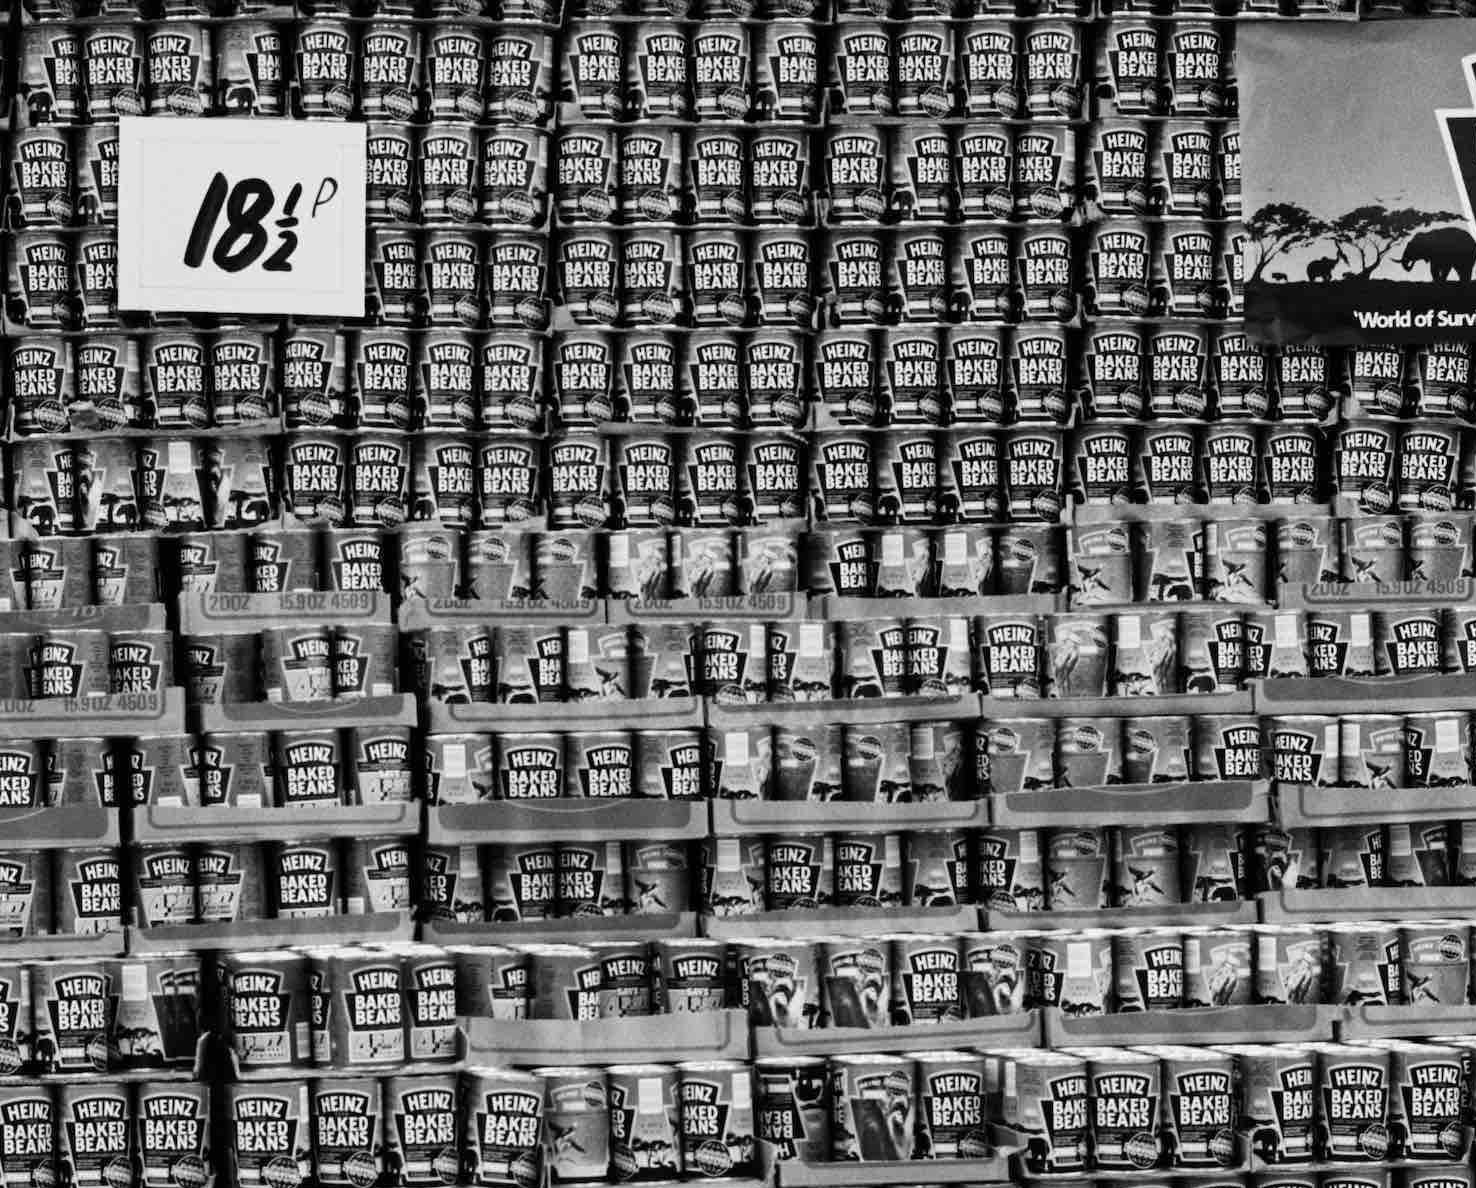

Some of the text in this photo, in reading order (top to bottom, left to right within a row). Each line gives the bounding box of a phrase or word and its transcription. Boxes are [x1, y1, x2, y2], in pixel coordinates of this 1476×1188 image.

[90, 39, 129, 55] HEINZ
[438, 39, 476, 56] HEINZ
[88, 57, 132, 71] BAKED
[435, 57, 479, 73] BAKED
[89, 71, 132, 84] BEANS
[435, 70, 477, 84] BEANS
[965, 138, 1004, 154] HEINZ
[962, 156, 1007, 170] BAKED
[962, 170, 1006, 183] BEANS
[1414, 310, 1434, 327] of
[565, 344, 604, 361] HEINZ
[826, 344, 867, 359] HEINZ
[562, 364, 607, 378] BAKED
[823, 362, 869, 375] BAKED
[562, 377, 606, 390] BEANS
[823, 375, 868, 387] BEANS
[1345, 433, 1383, 450] HEINZ
[296, 445, 335, 462] HEINZ
[1342, 451, 1386, 467] BAKED
[293, 465, 338, 479] BAKED
[1342, 464, 1384, 478] BEANS
[293, 478, 337, 491] BEANS
[994, 627, 1033, 643] HEINZ
[991, 645, 1036, 659] BAKED
[991, 659, 1035, 672] BEANS
[289, 746, 331, 764] HEINZ
[287, 765, 335, 781] BAKED
[288, 780, 335, 796] BEANS
[149, 1098, 193, 1117] HEINZ
[408, 1093, 451, 1112] HEINZ
[145, 1119, 196, 1136] BAKED
[406, 1113, 455, 1129] BAKED
[145, 1135, 195, 1150] BEANS
[407, 1127, 455, 1144] BEANS
